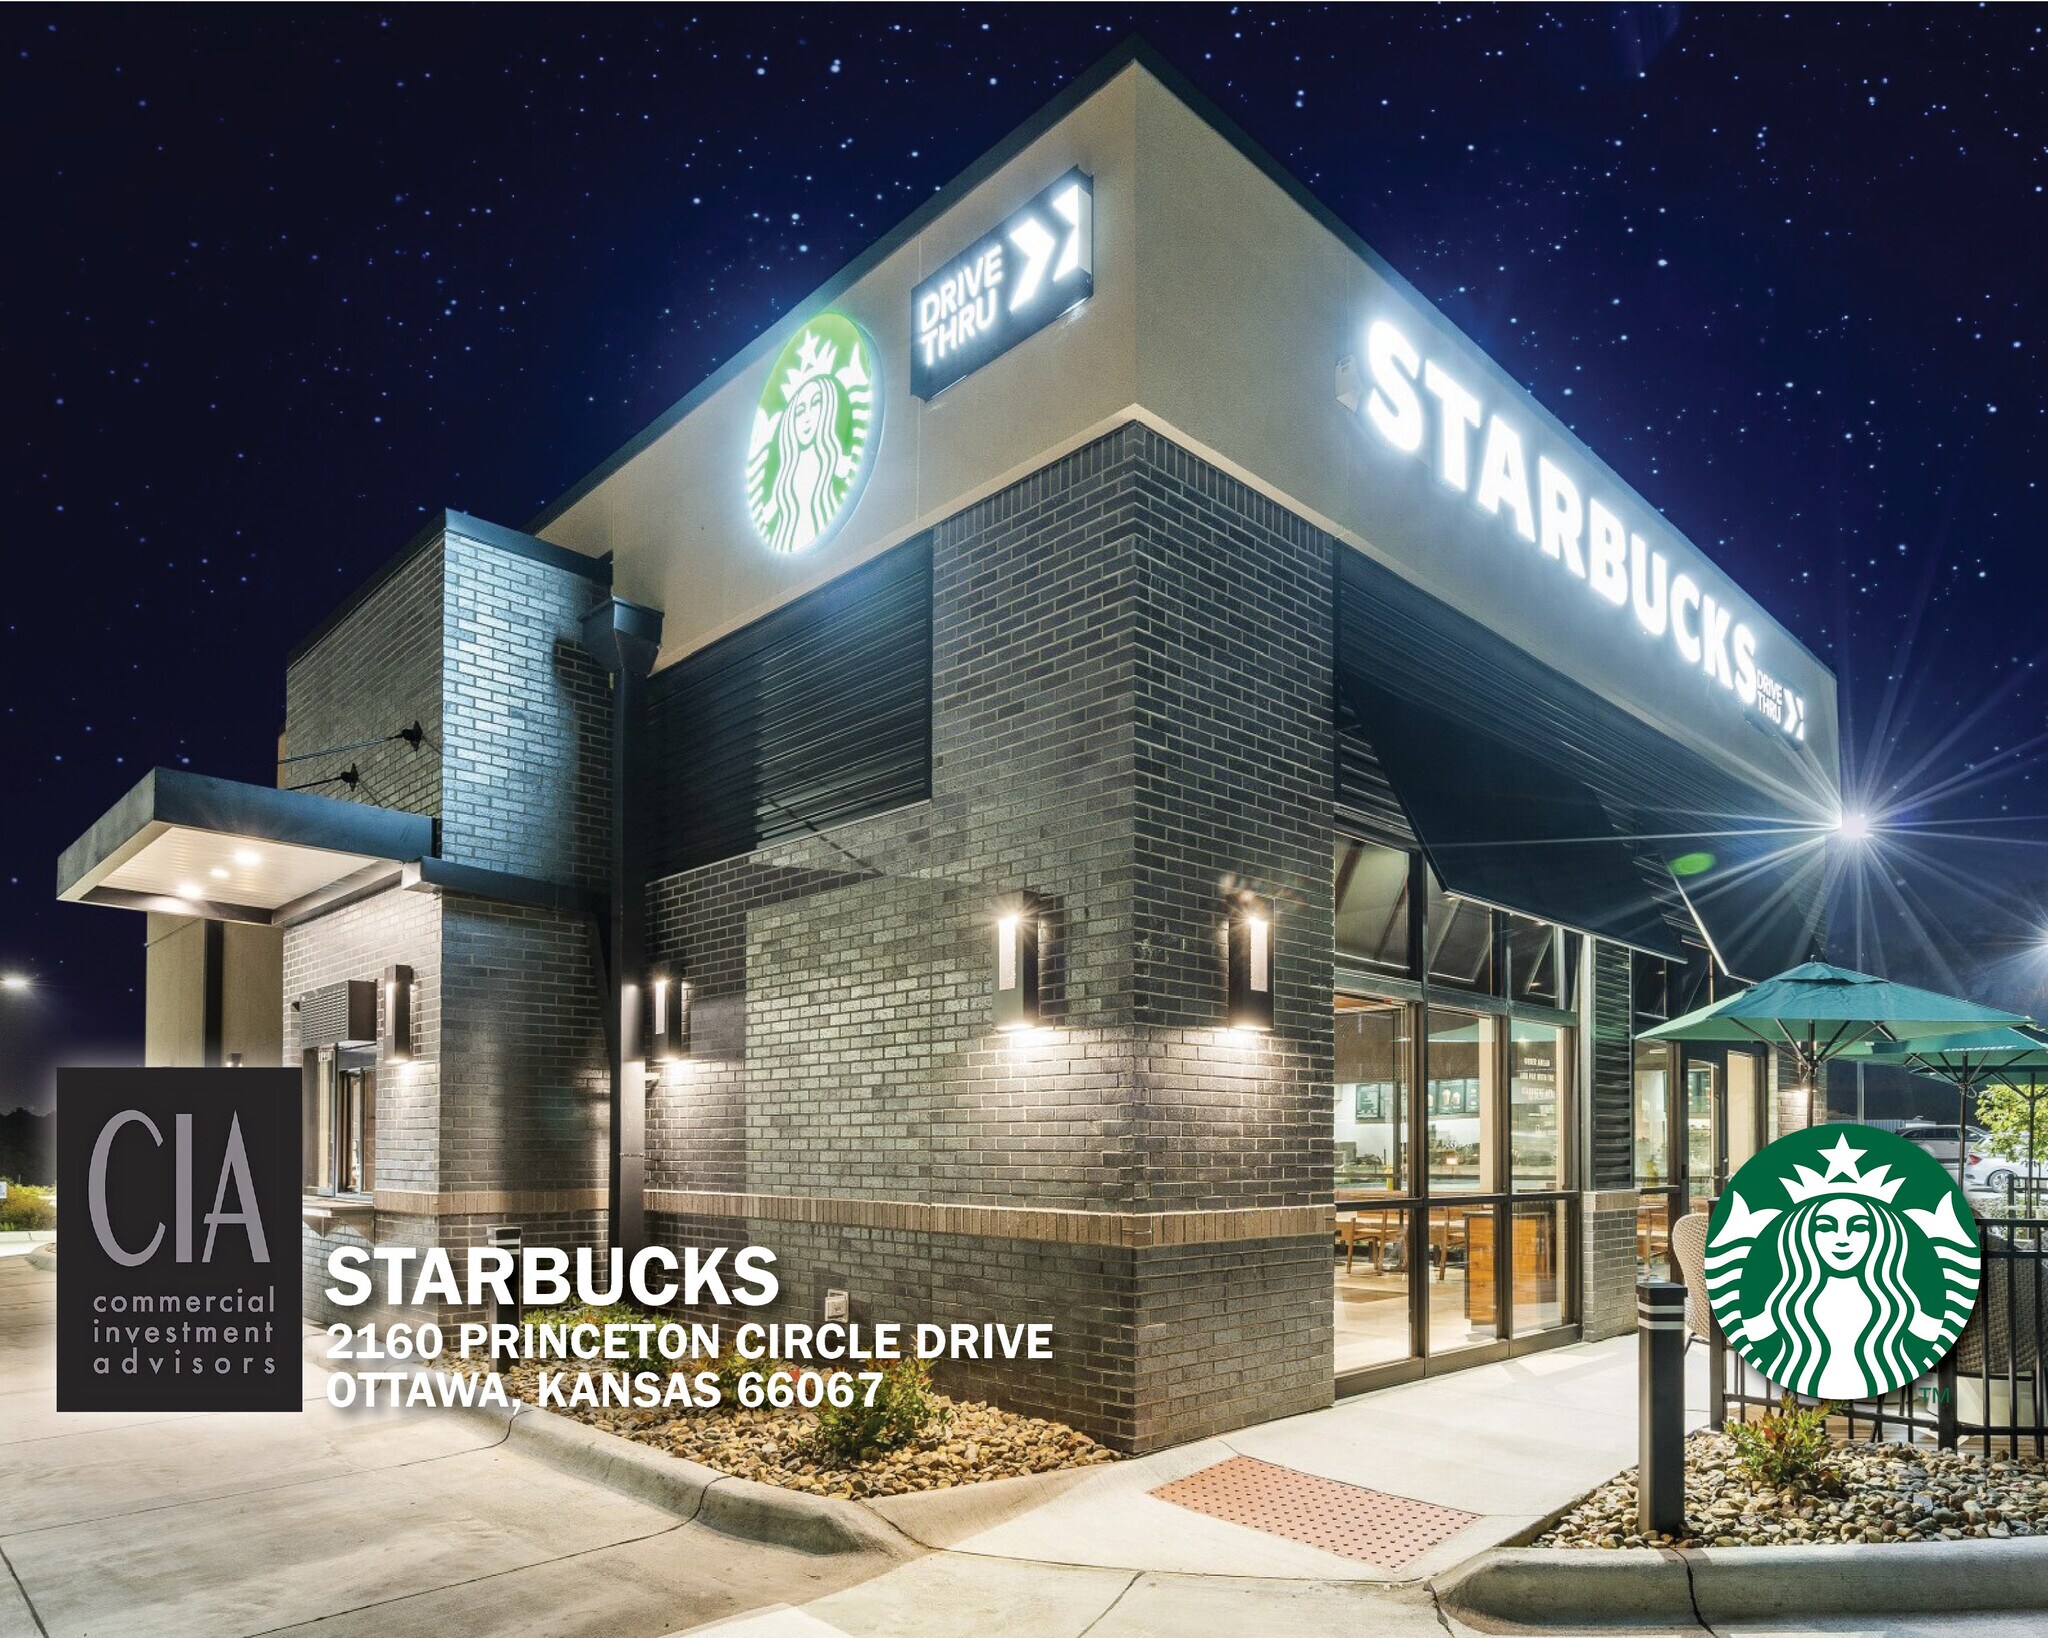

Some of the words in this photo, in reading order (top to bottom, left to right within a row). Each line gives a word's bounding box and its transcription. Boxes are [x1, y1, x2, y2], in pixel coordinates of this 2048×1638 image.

[920, 244, 1003, 334] DRIVE
[920, 287, 998, 367] THRU
[1367, 319, 1757, 705] STARBUCKS
[1756, 668, 1783, 706] DRIVE
[1757, 690, 1782, 725] THRU
